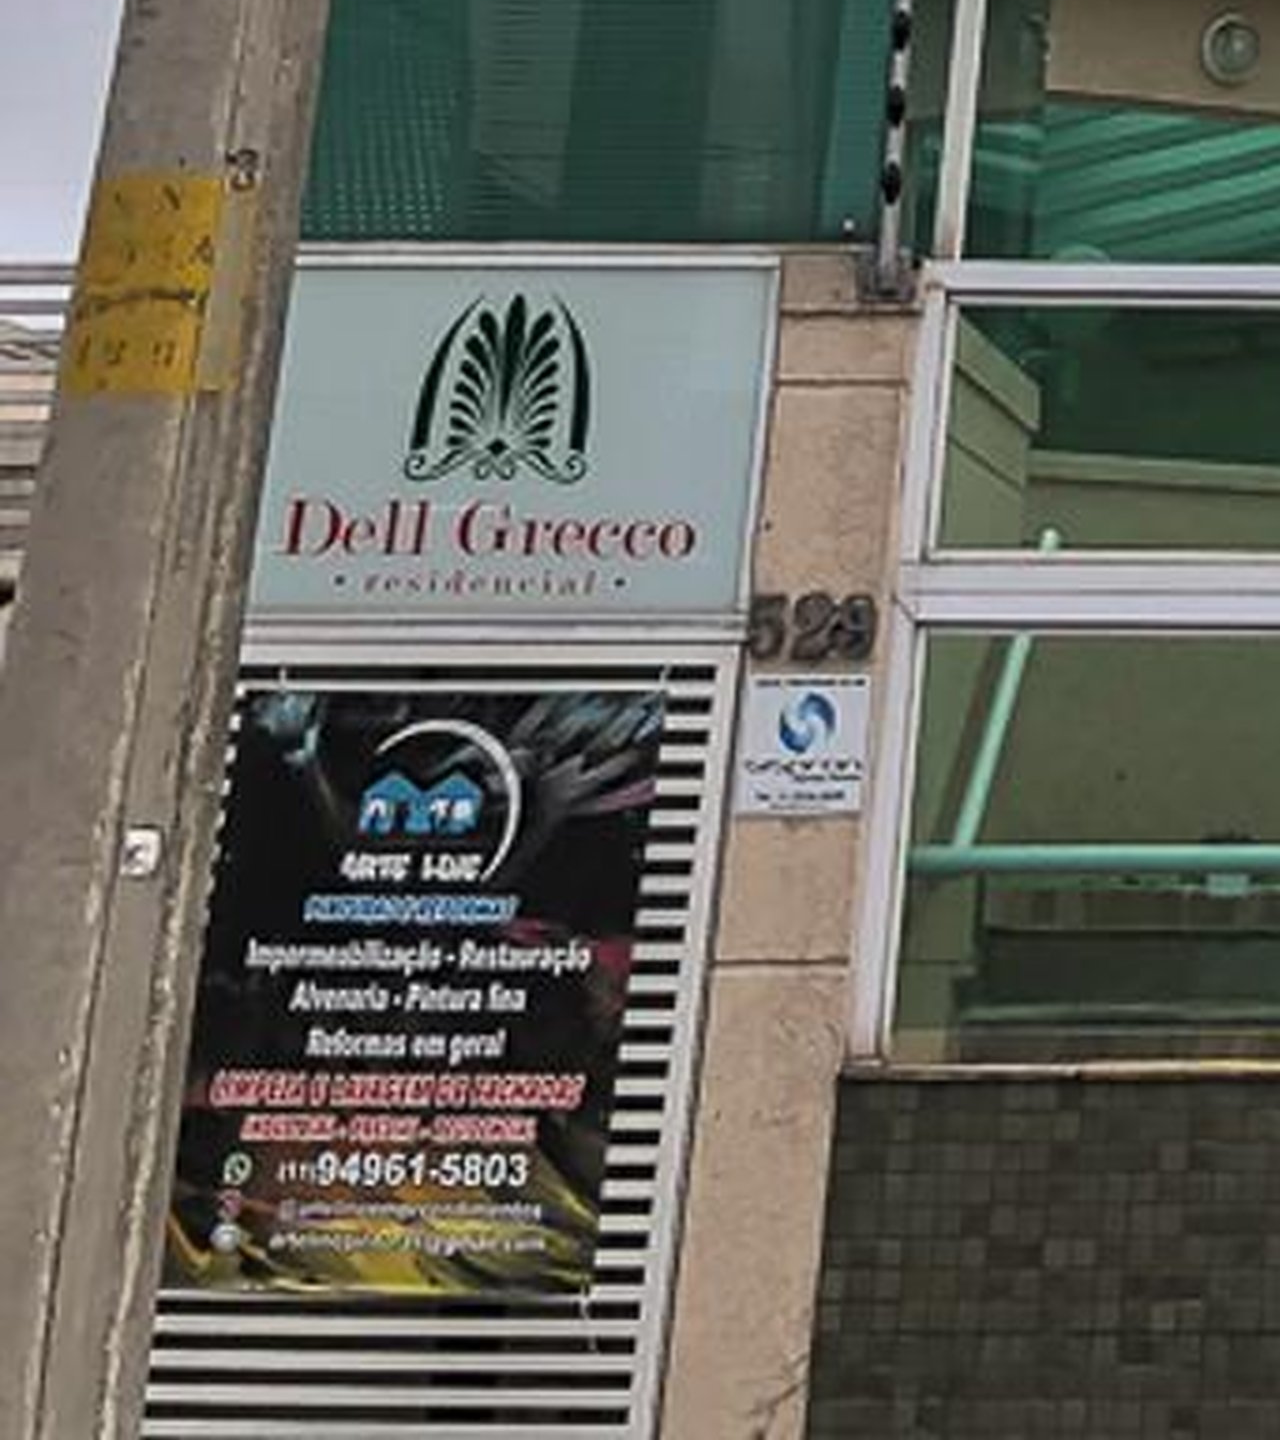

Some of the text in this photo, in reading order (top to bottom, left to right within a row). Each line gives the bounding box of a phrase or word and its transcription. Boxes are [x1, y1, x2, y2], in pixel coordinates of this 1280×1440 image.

[273, 499, 696, 558] Dell Grecco
[364, 570, 598, 595] residencial
[750, 594, 876, 661] 529
[288, 981, 388, 1011] Alvenaria
[404, 982, 482, 1011] Pintura
[305, 1027, 507, 1066] Reformas em geral
